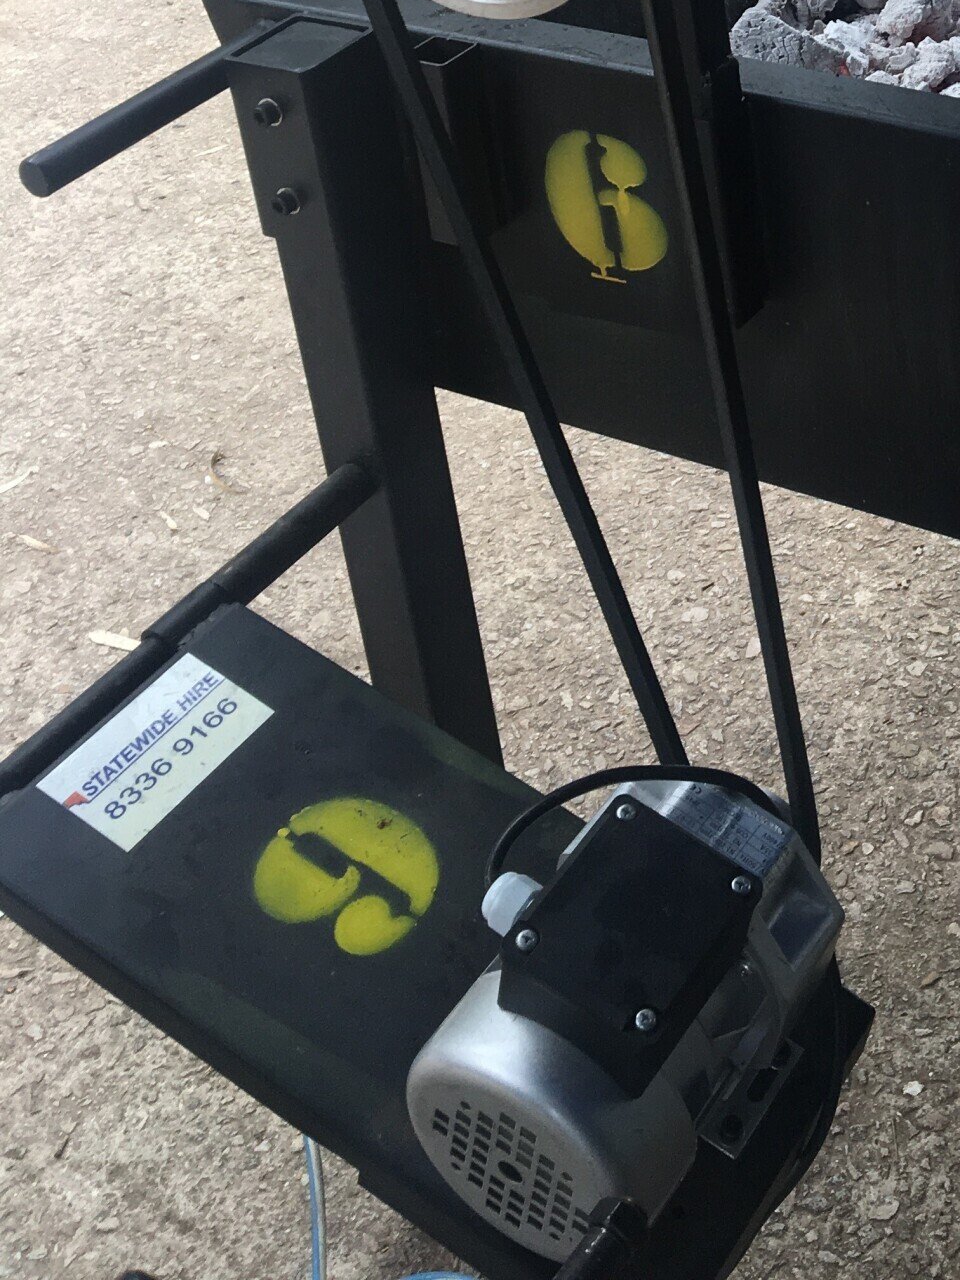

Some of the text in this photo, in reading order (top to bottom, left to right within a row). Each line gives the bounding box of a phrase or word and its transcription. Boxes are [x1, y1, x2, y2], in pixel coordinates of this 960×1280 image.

[81, 672, 220, 796] STATEWIDE HIRE
[104, 697, 238, 820] 8336 9166
